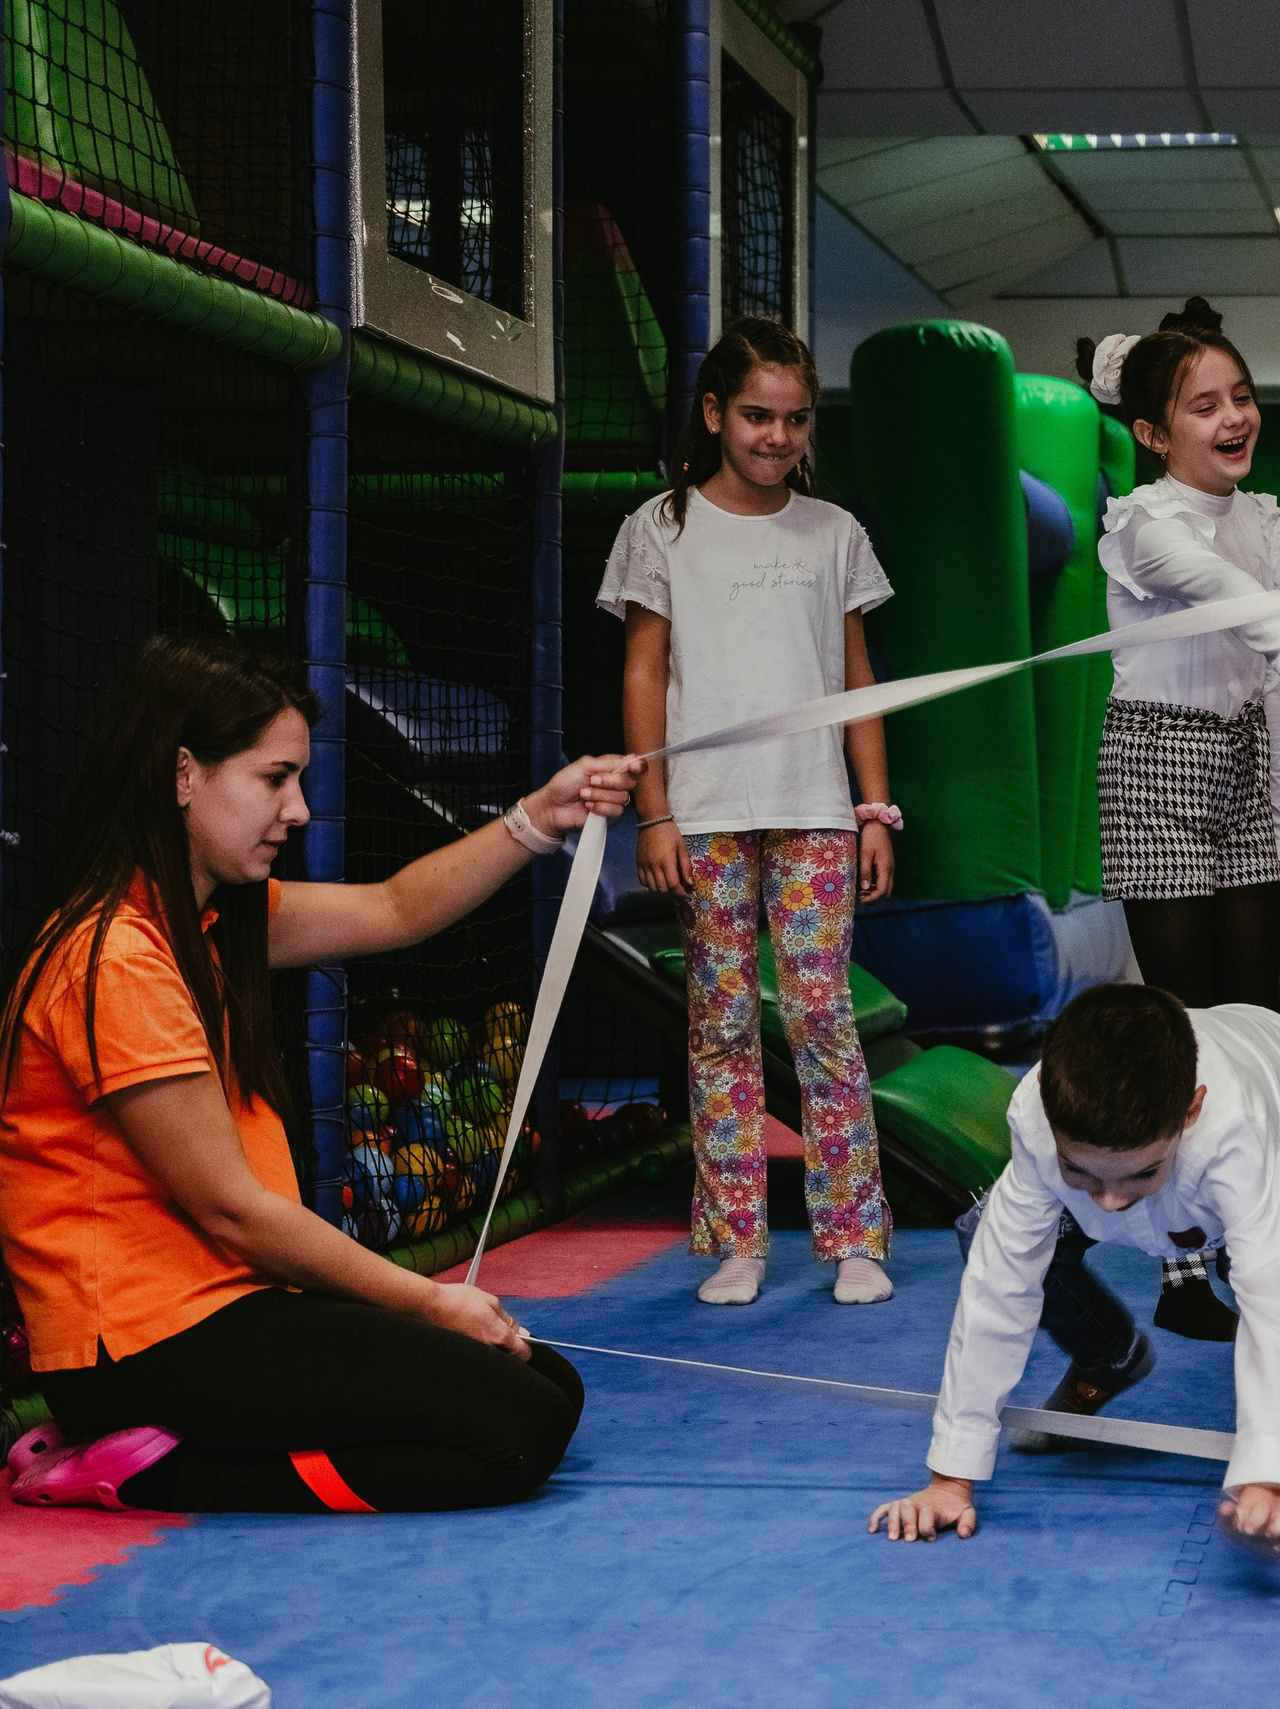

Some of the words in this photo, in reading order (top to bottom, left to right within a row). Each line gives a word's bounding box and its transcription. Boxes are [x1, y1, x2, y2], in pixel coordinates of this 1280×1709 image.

[753, 554, 791, 571] make
[729, 572, 767, 601] good
[771, 572, 815, 589] stories
